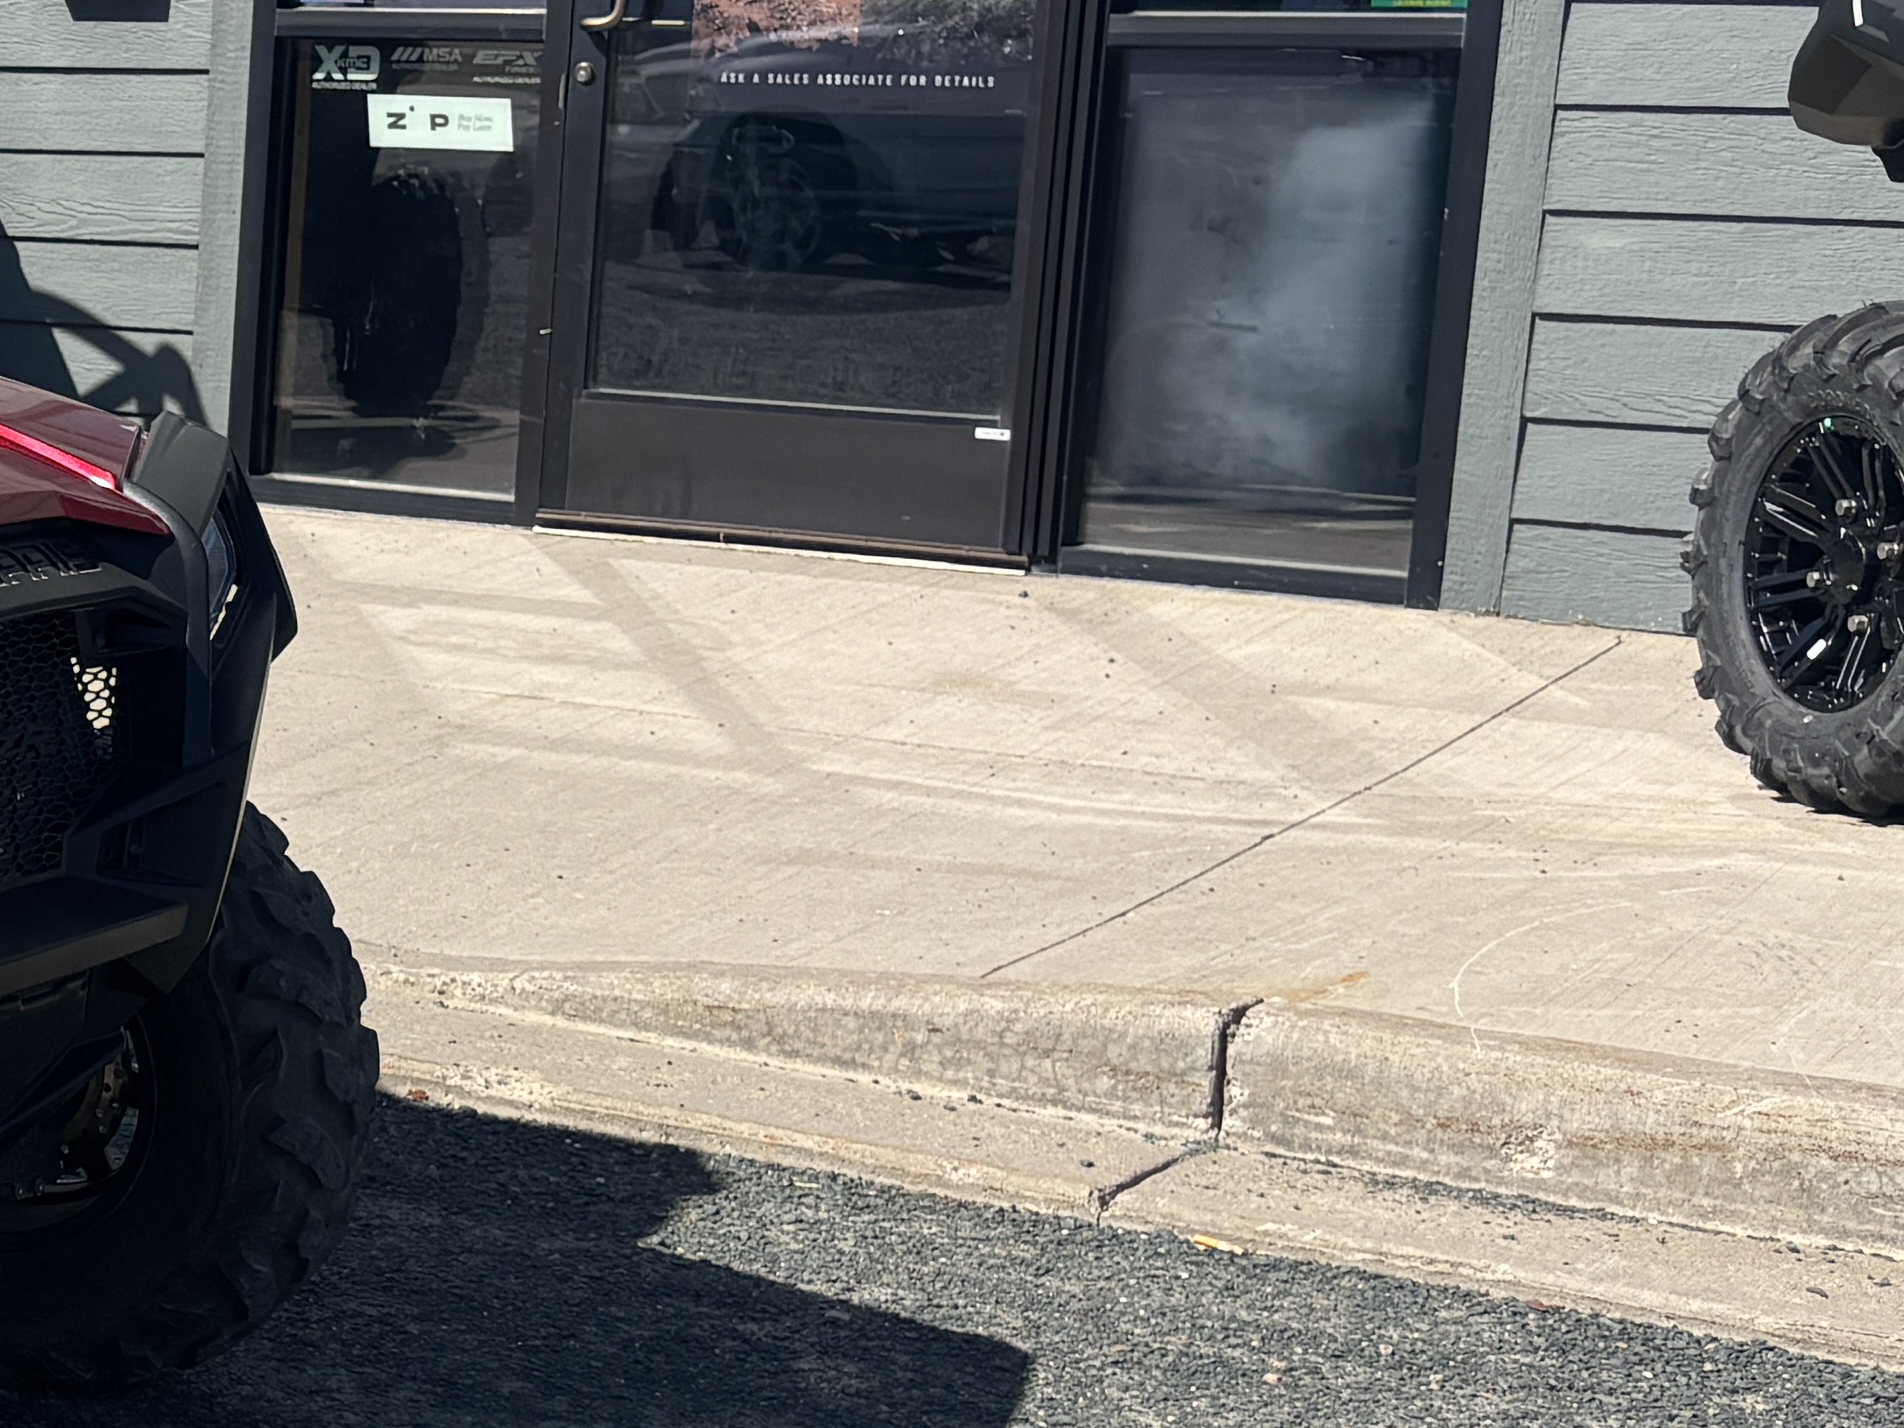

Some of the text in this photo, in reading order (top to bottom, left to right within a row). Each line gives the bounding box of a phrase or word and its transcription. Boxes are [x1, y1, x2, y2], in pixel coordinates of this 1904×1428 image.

[311, 44, 381, 80] XD
[423, 47, 462, 63] MSA
[472, 50, 542, 66] EFX
[721, 71, 995, 88] ASK A SALES ASSOCIATE FOR DETAILS
